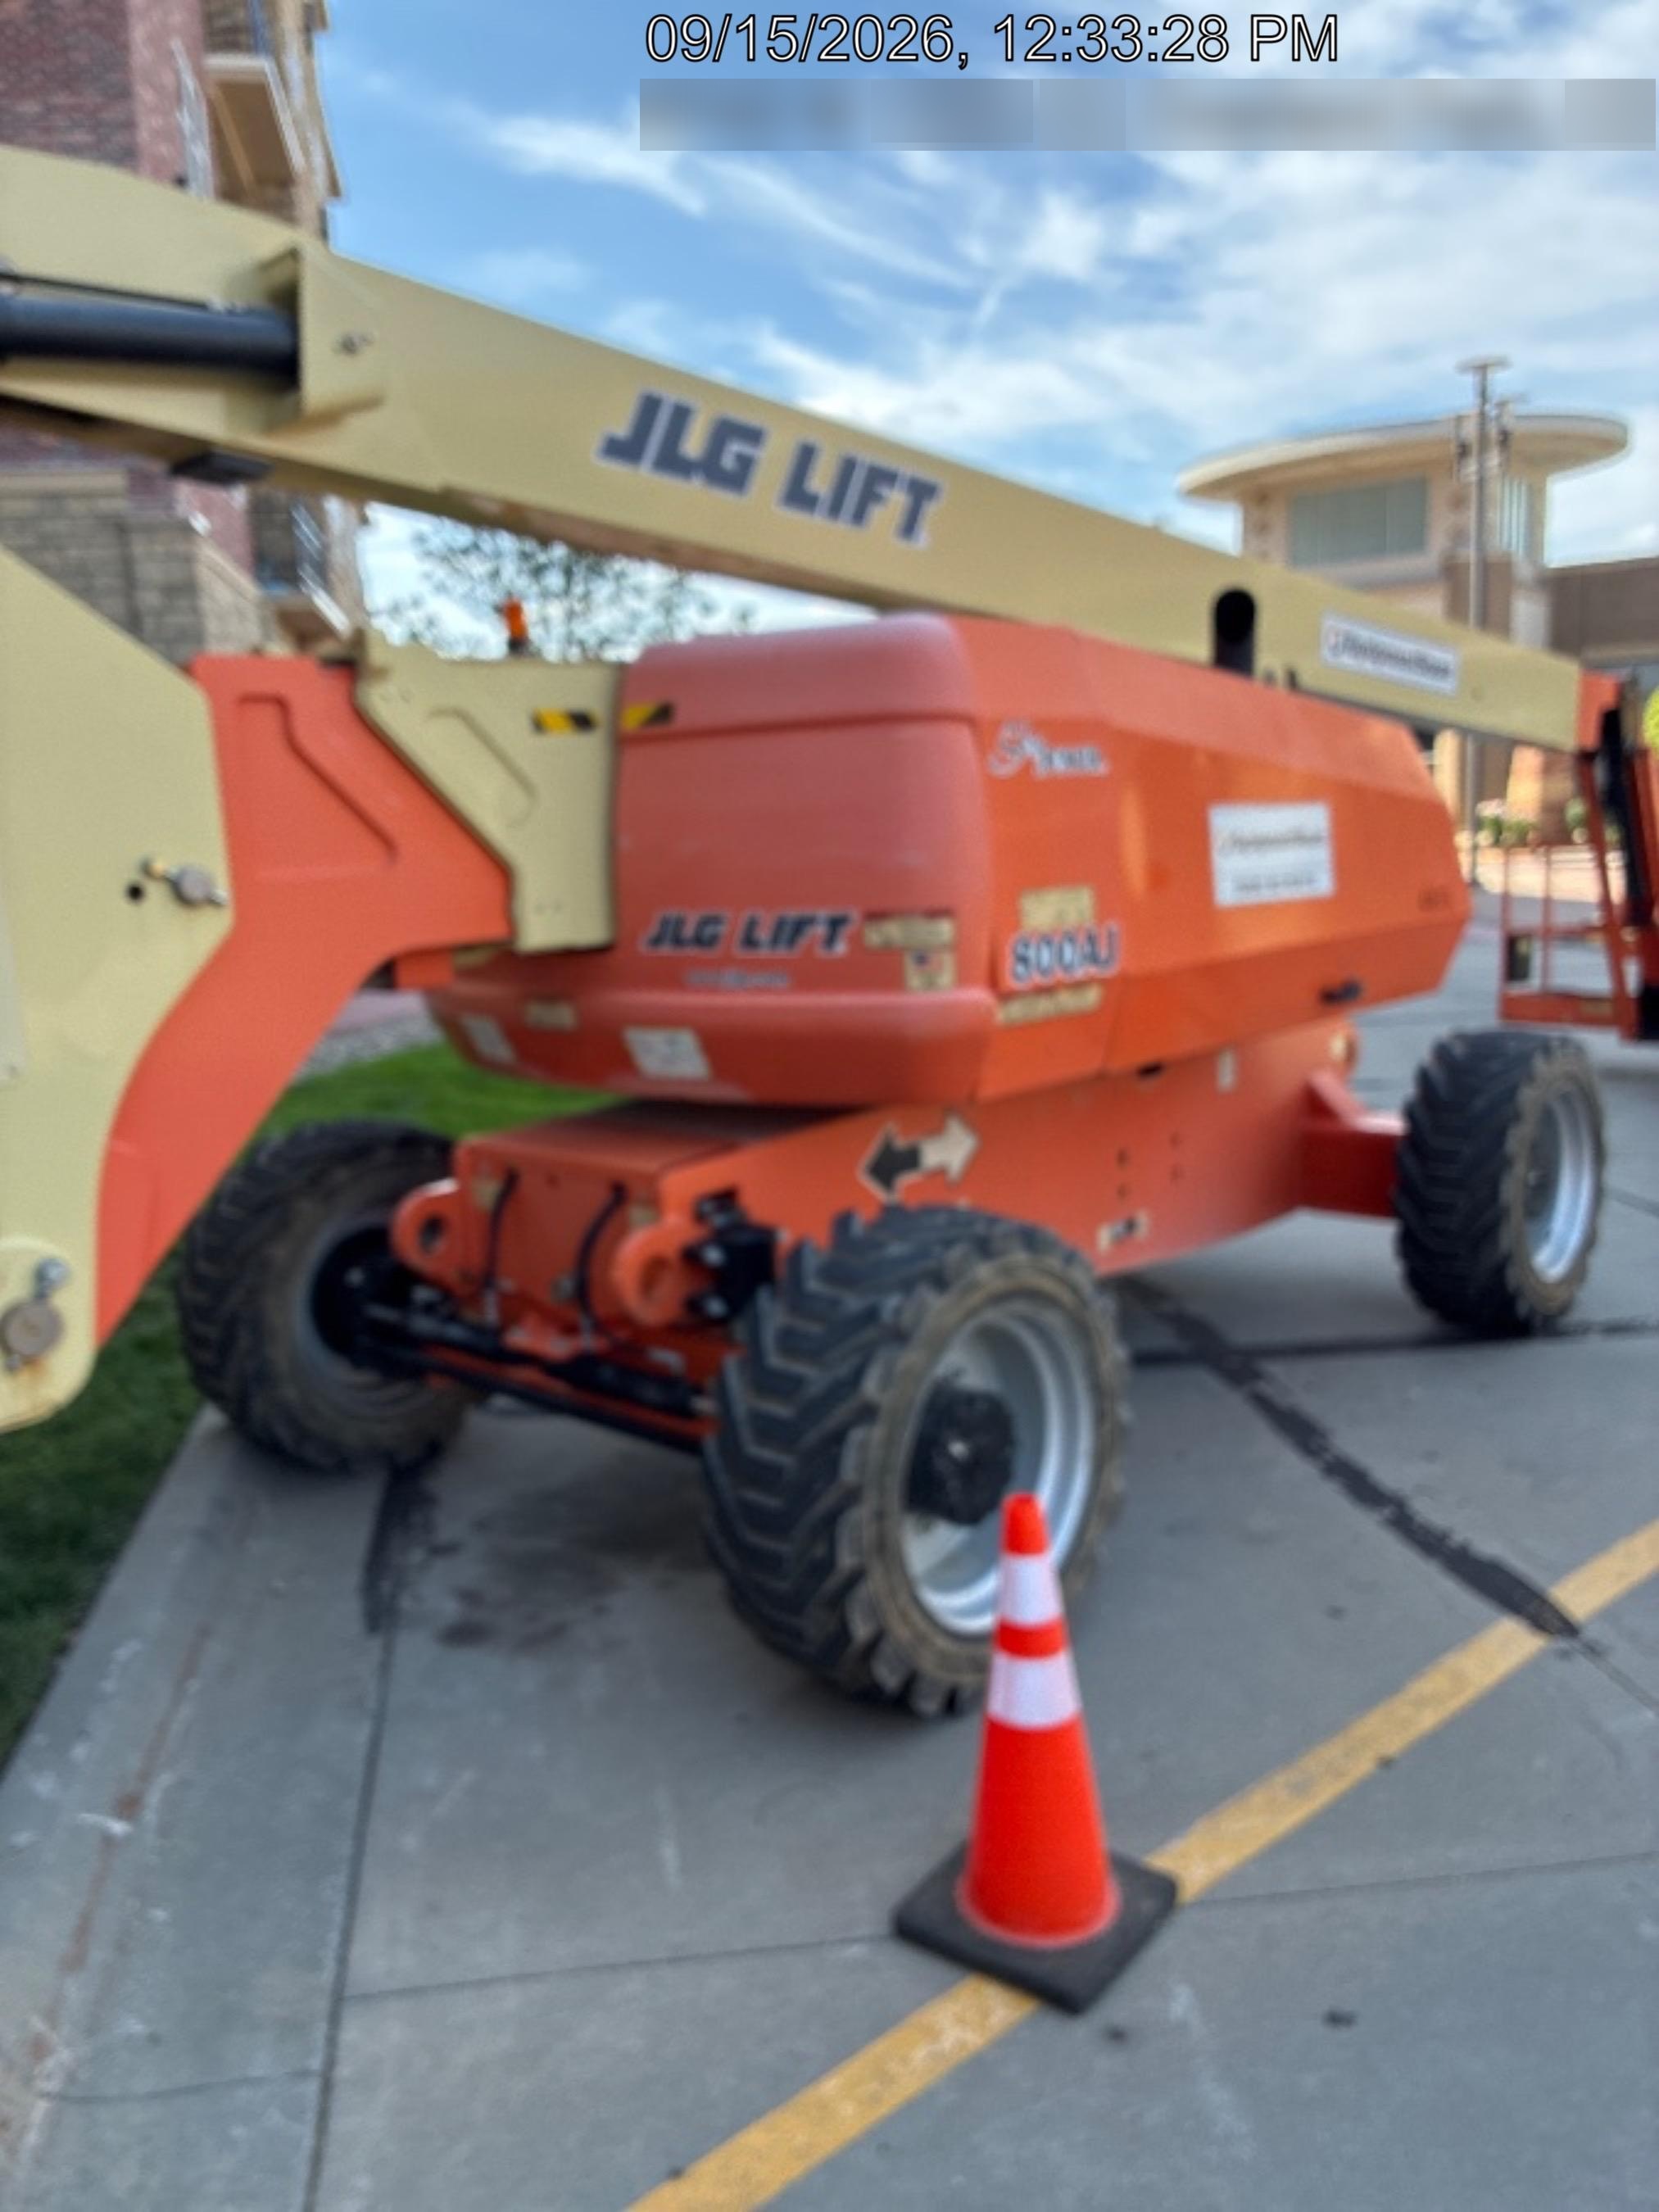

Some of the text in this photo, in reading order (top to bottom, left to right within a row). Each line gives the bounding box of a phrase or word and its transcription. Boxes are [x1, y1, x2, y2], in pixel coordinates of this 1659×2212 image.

[596, 391, 942, 547] JLG LIFT
[642, 909, 728, 954] JLG
[736, 909, 857, 957] LIFT
[1009, 922, 1121, 988] 800AJ
